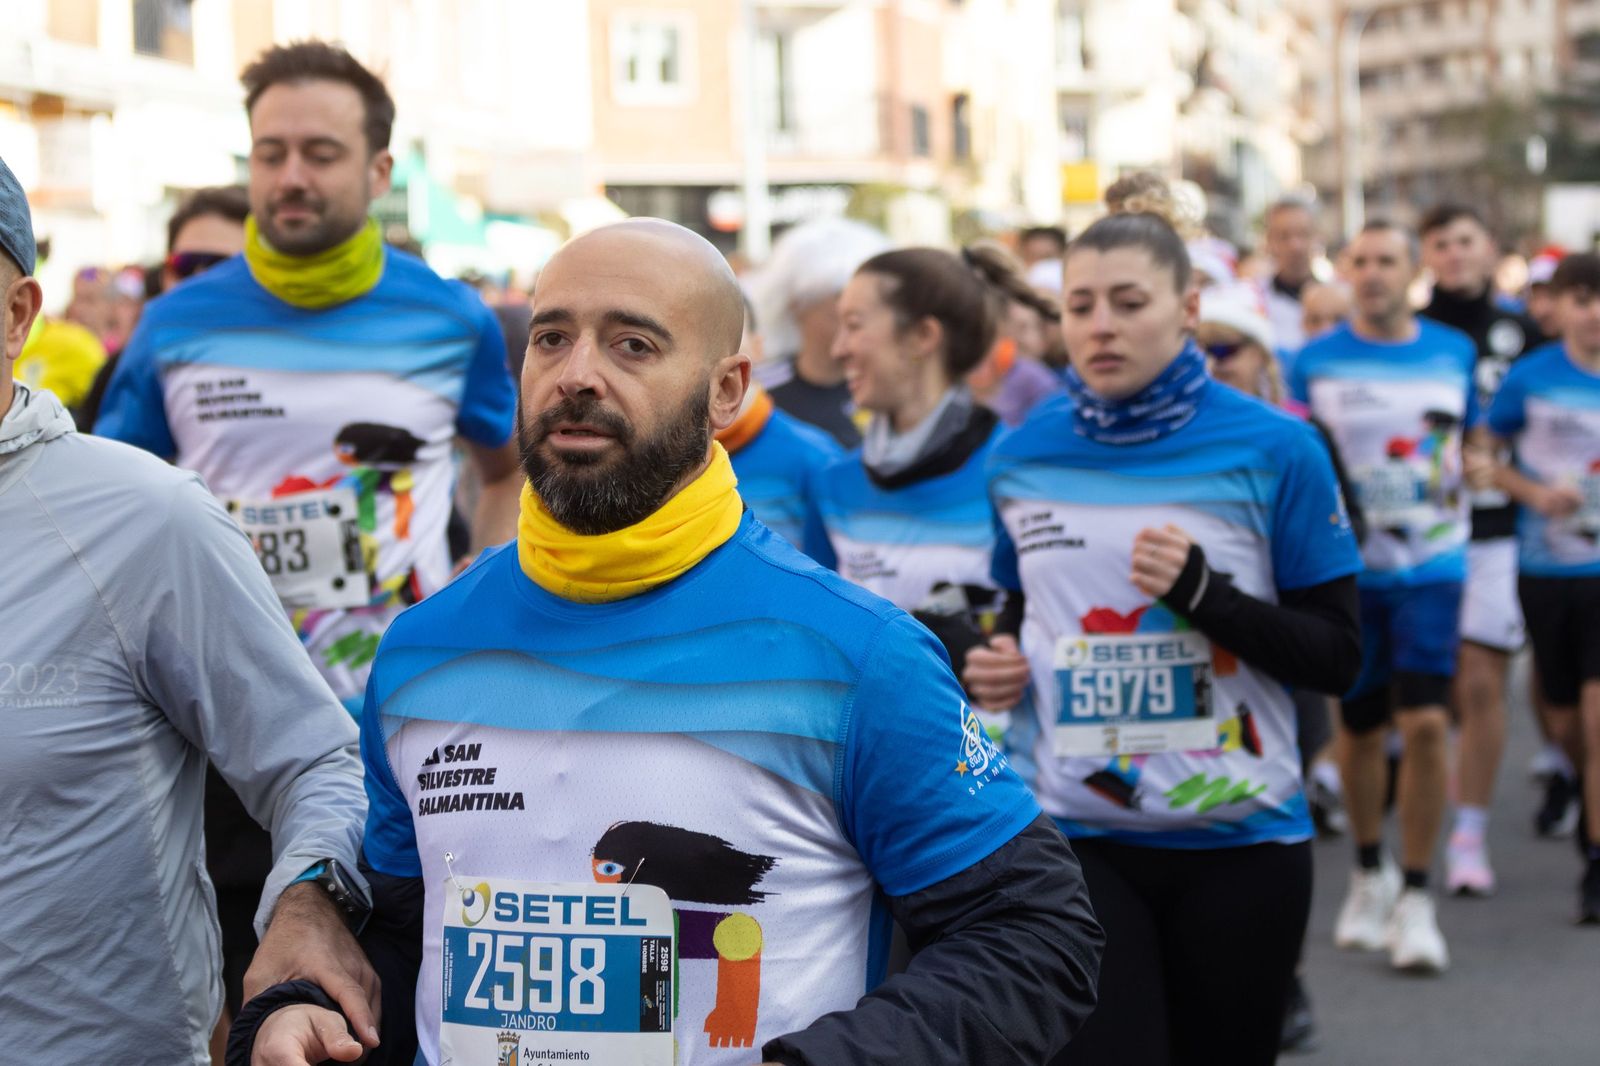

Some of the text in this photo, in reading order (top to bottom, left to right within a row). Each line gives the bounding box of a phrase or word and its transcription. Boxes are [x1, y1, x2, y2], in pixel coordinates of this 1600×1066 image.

[1092, 642, 1194, 662] SETEL
[0, 662, 79, 695] 2023
[1071, 667, 1174, 718] 5979
[444, 743, 482, 764] SAN
[417, 767, 497, 791] SILVESTRE
[419, 792, 525, 816] SALMANTINA
[494, 891, 648, 927] SETEL
[661, 946, 669, 972] 2598
[464, 932, 606, 1015] 2598
[500, 1013, 557, 1031] JANDRO
[523, 1047, 590, 1061] Ayuntamiento
